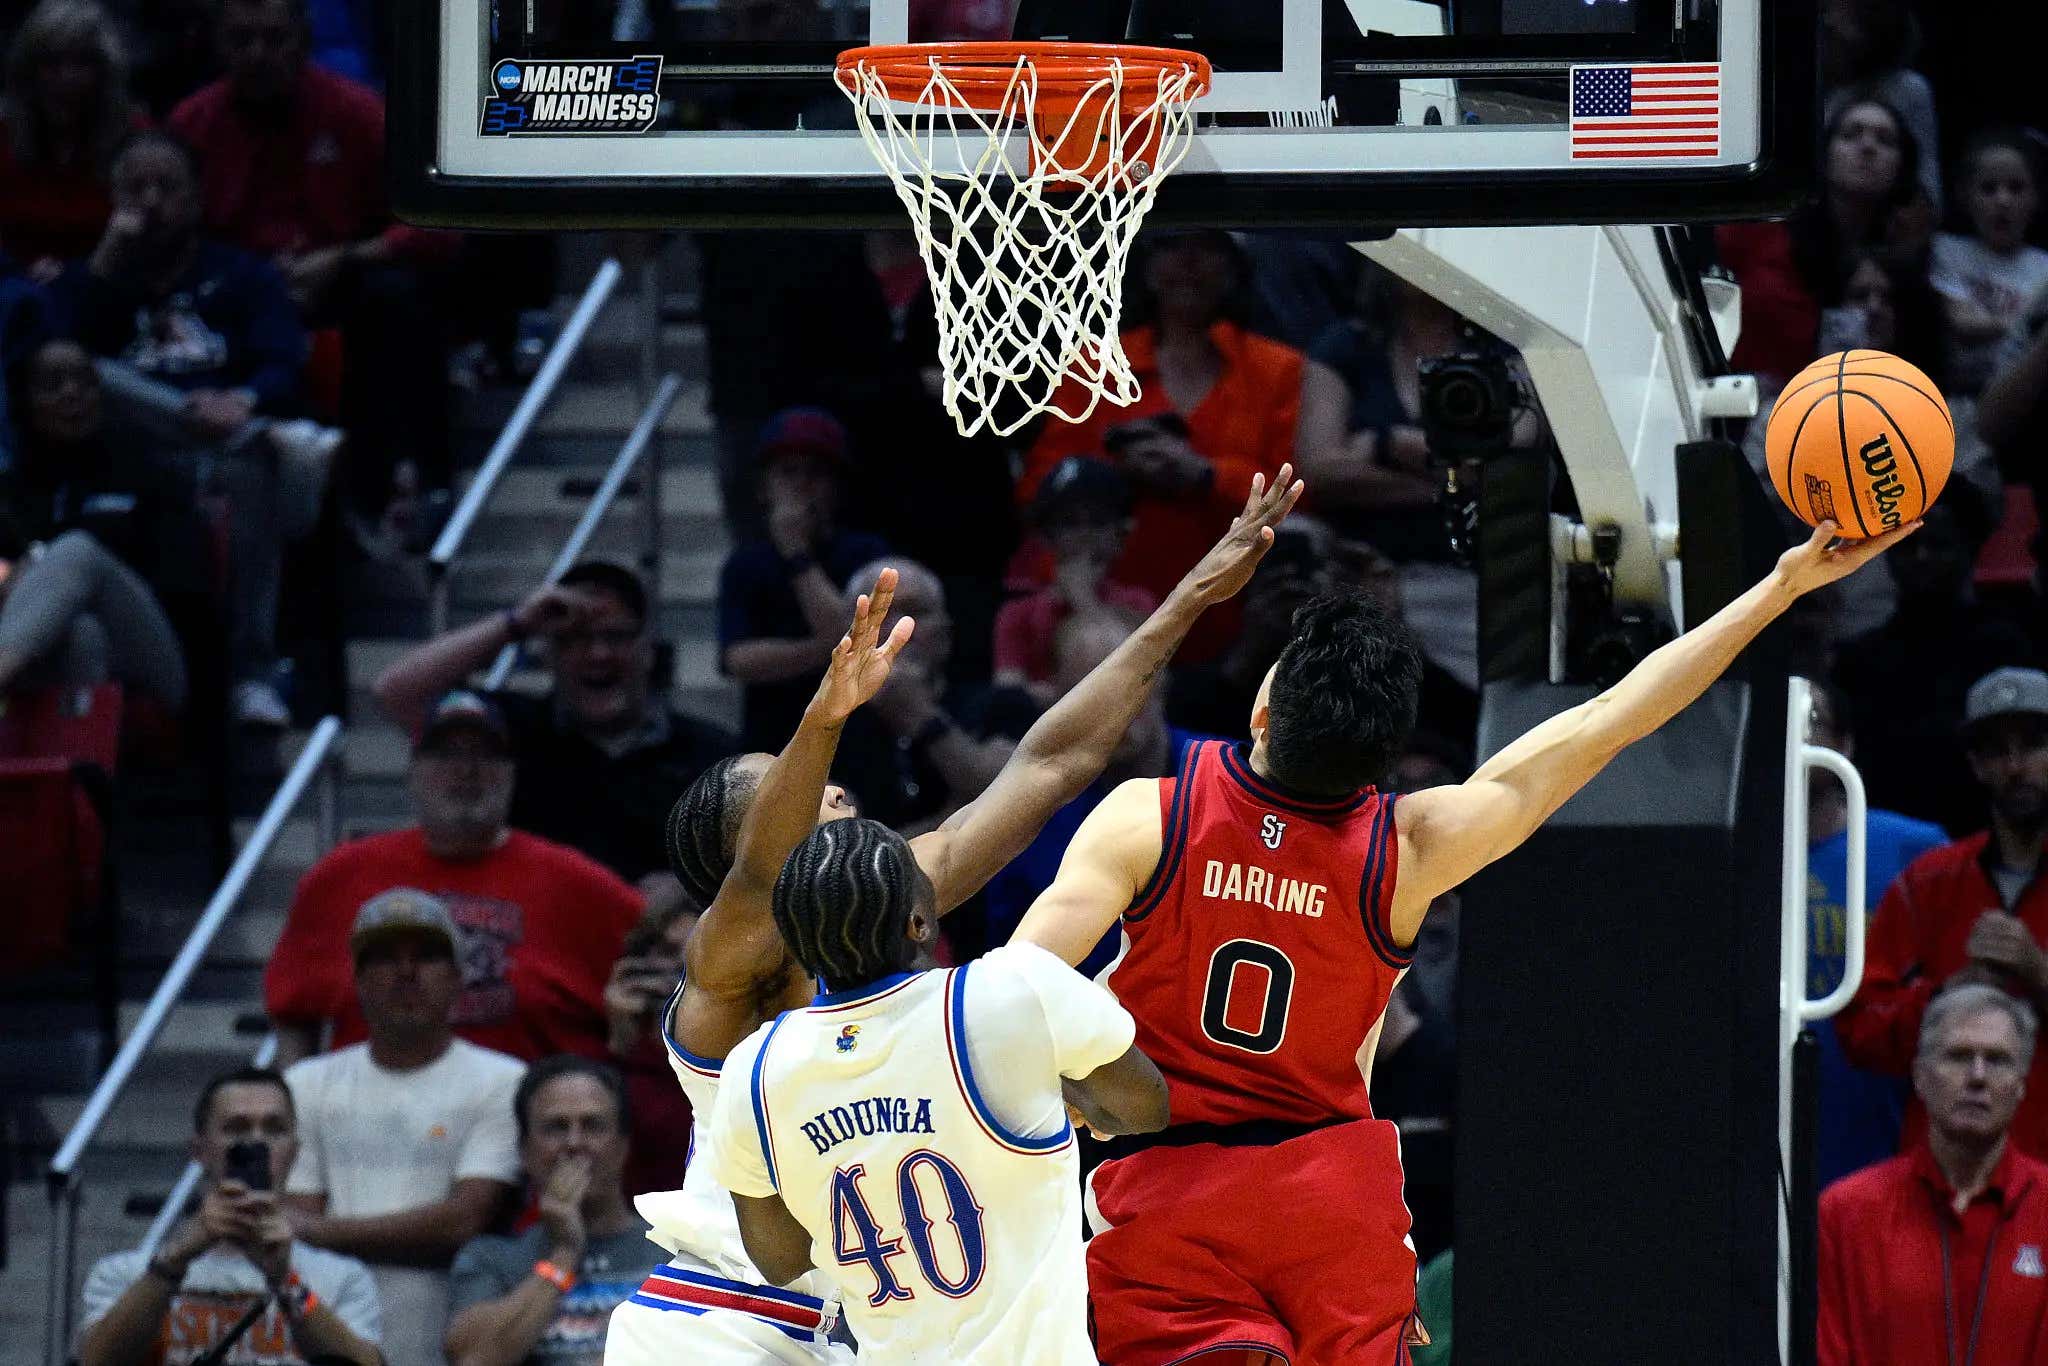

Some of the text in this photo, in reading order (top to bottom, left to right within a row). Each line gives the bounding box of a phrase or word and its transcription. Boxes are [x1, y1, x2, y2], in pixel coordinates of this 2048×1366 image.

[521, 65, 613, 93] MARCH
[532, 94, 654, 121] MADNESS
[1202, 860, 1328, 918] DARLING
[1200, 938, 1296, 1054] 0
[800, 1097, 936, 1156] BIDUNGA
[830, 1148, 987, 1307] 40
